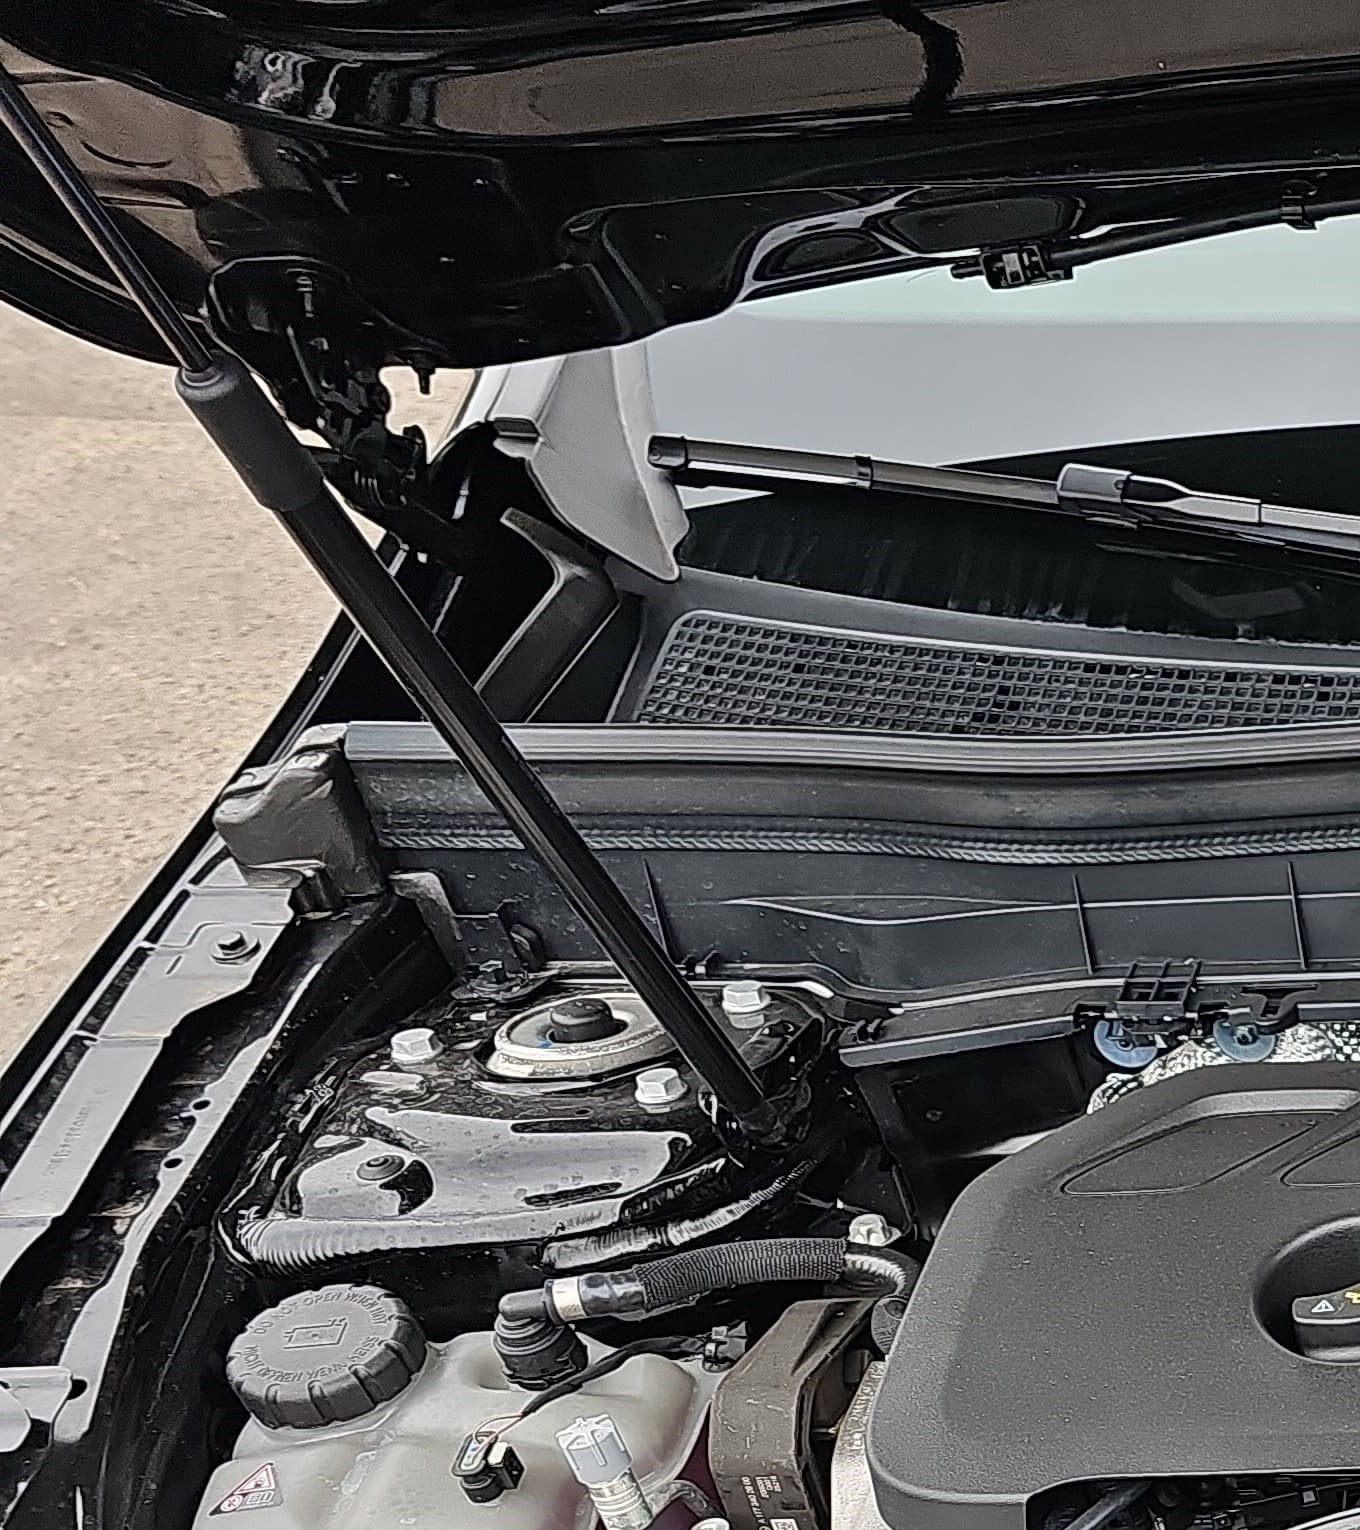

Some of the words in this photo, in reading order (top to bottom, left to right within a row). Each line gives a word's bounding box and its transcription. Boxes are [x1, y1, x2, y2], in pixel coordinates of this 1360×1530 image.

[254, 1321, 273, 1335] DO
[272, 1302, 298, 1318] NOT
[304, 1292, 341, 1306] OPEN
